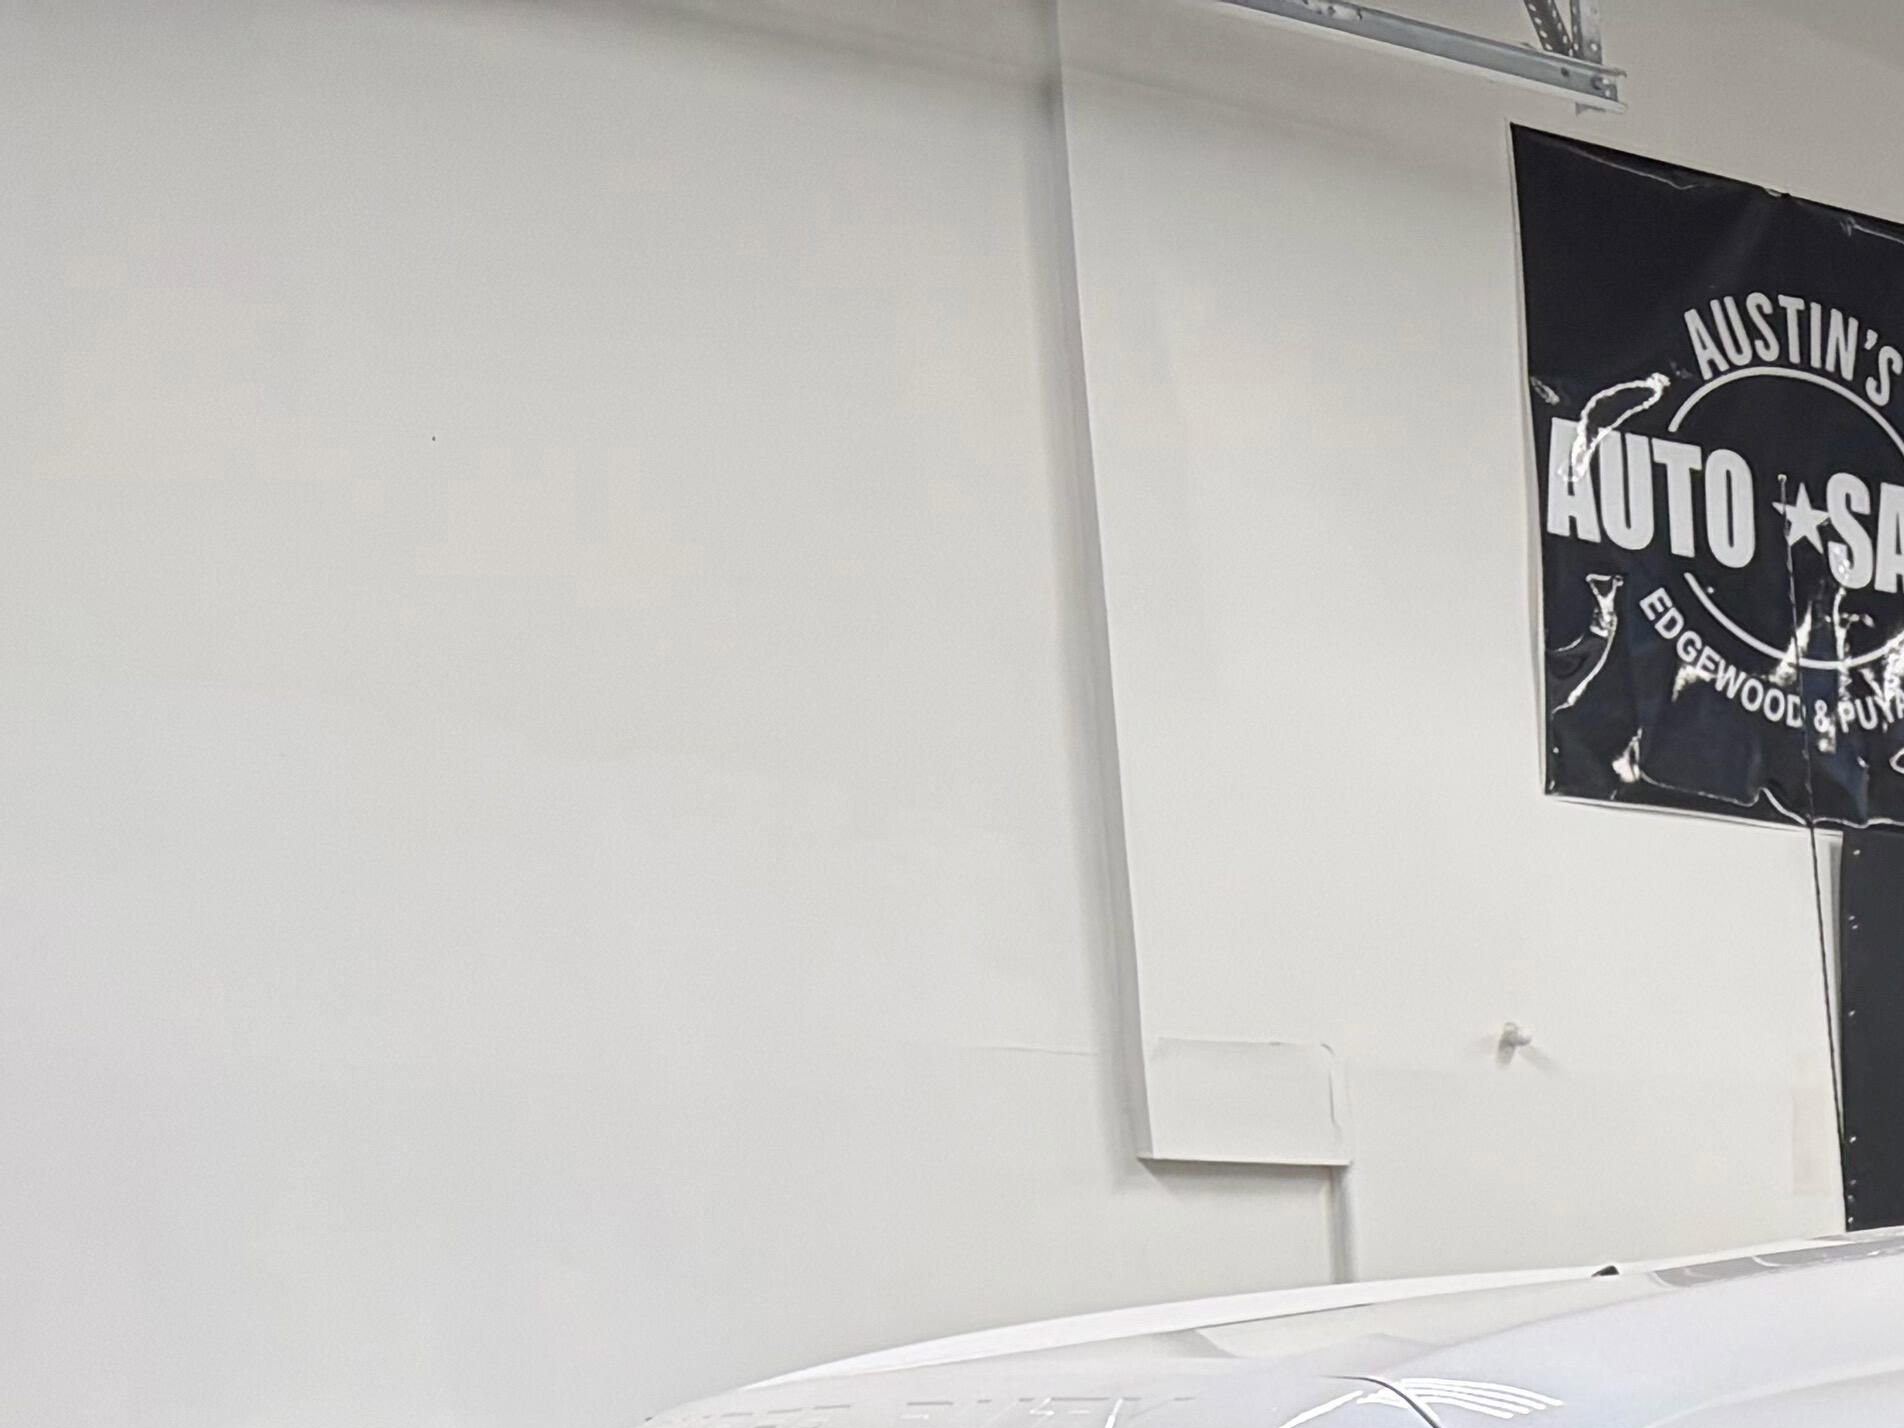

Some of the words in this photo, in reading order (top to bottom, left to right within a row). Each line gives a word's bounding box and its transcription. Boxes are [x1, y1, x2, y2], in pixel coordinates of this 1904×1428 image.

[1684, 292, 1903, 406] AUSTIN'S
[1546, 416, 1756, 569] AUTO
[1639, 587, 1805, 728] EDGEWOOD
[1814, 699, 1831, 732] &
